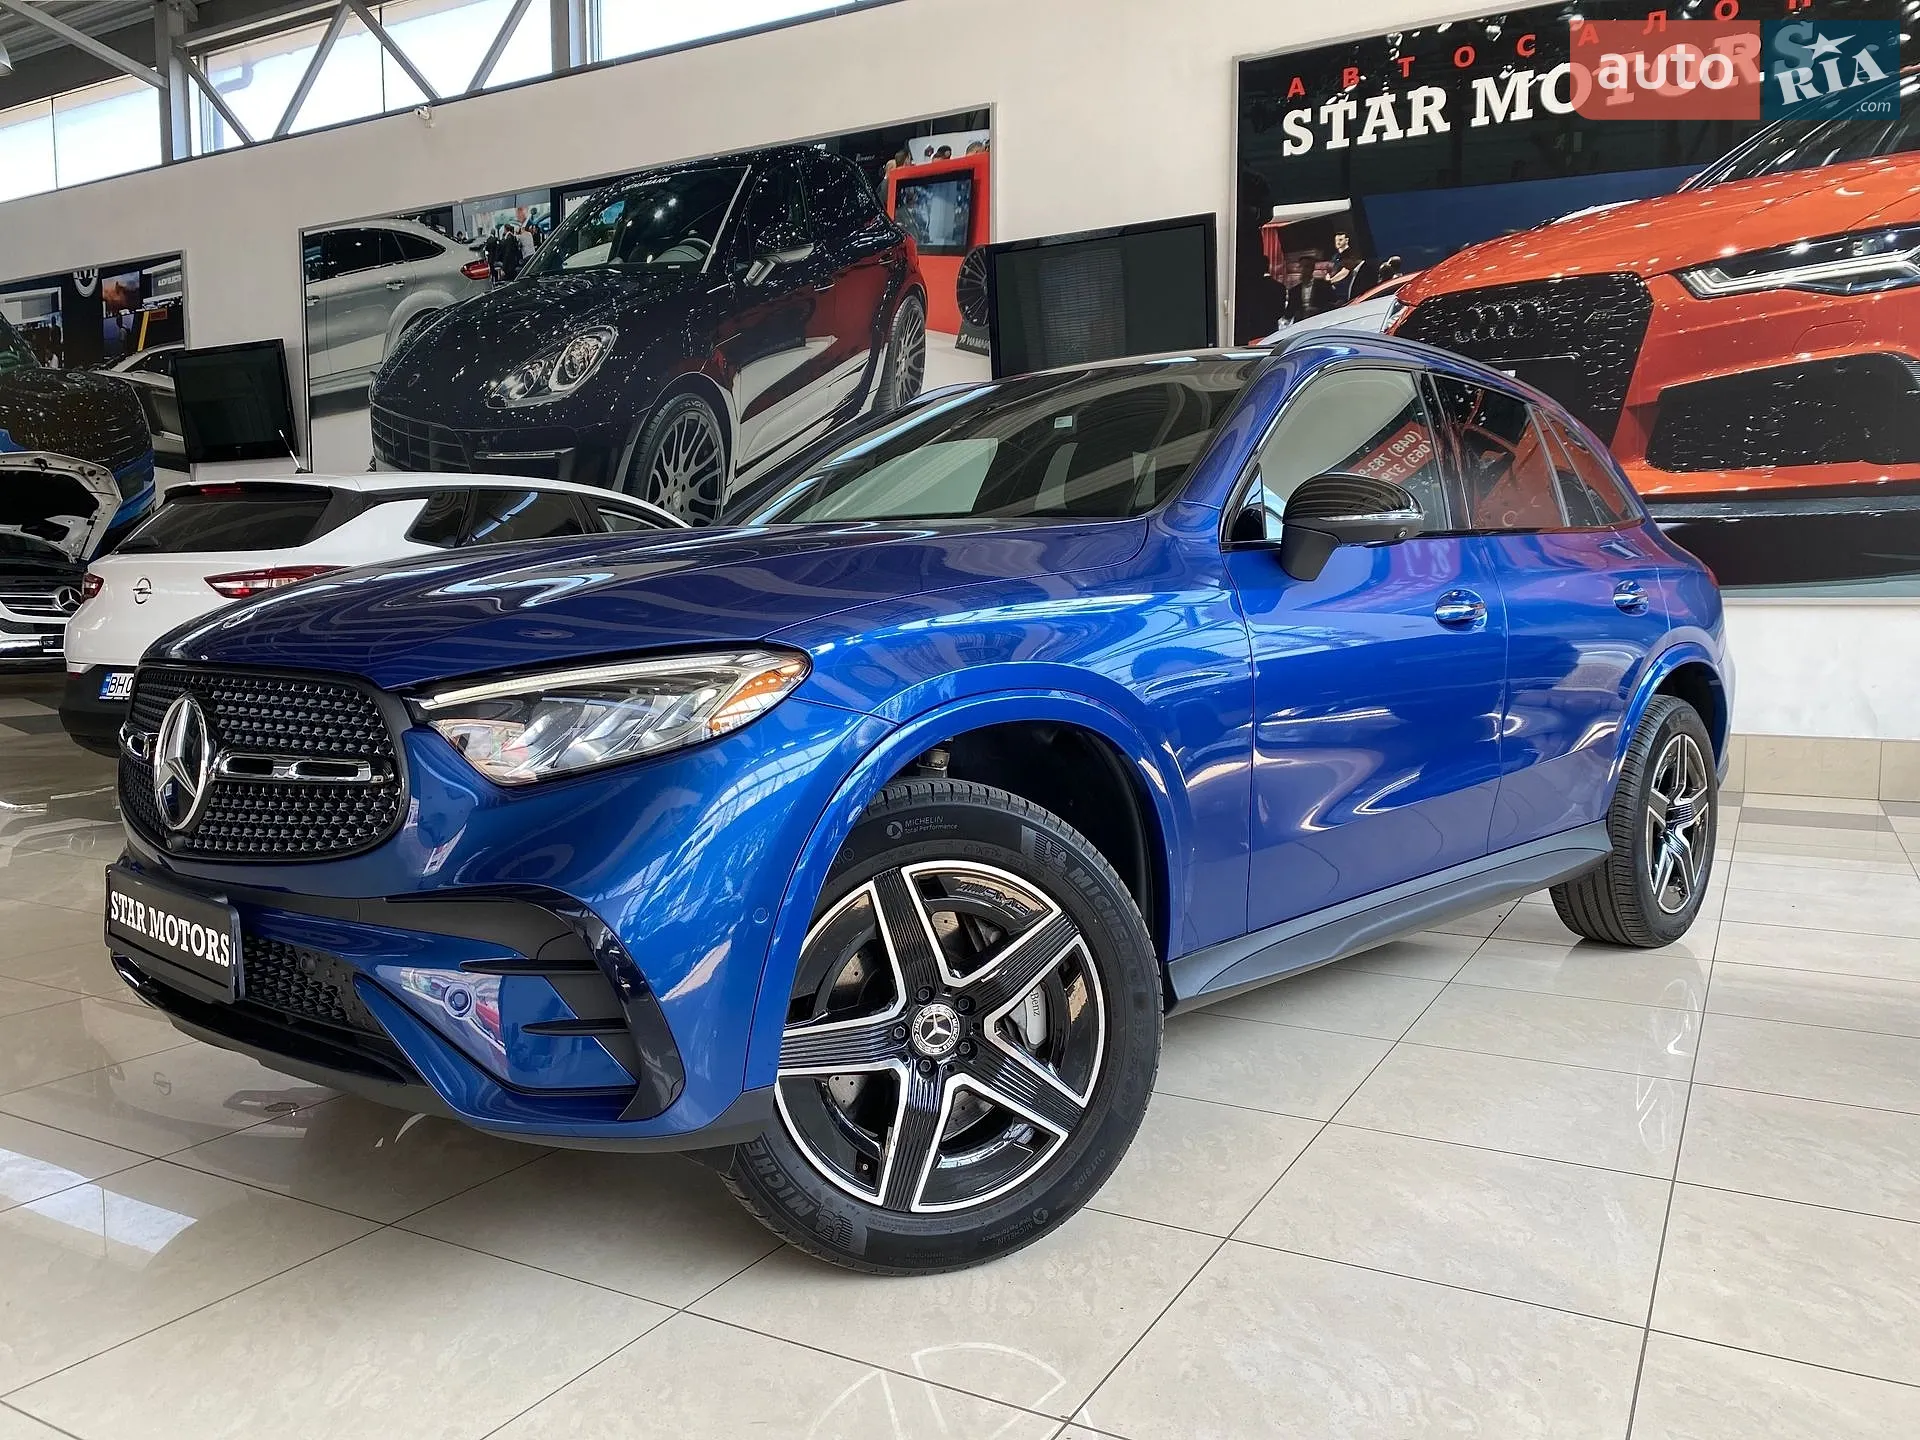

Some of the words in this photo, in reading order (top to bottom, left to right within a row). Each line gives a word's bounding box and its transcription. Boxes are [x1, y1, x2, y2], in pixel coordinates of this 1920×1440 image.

[1282, 85, 1451, 157] STAR
[904, 816, 944, 828] MICHELIN
[110, 890, 147, 935] STAR
[148, 906, 230, 968] MOTORS
